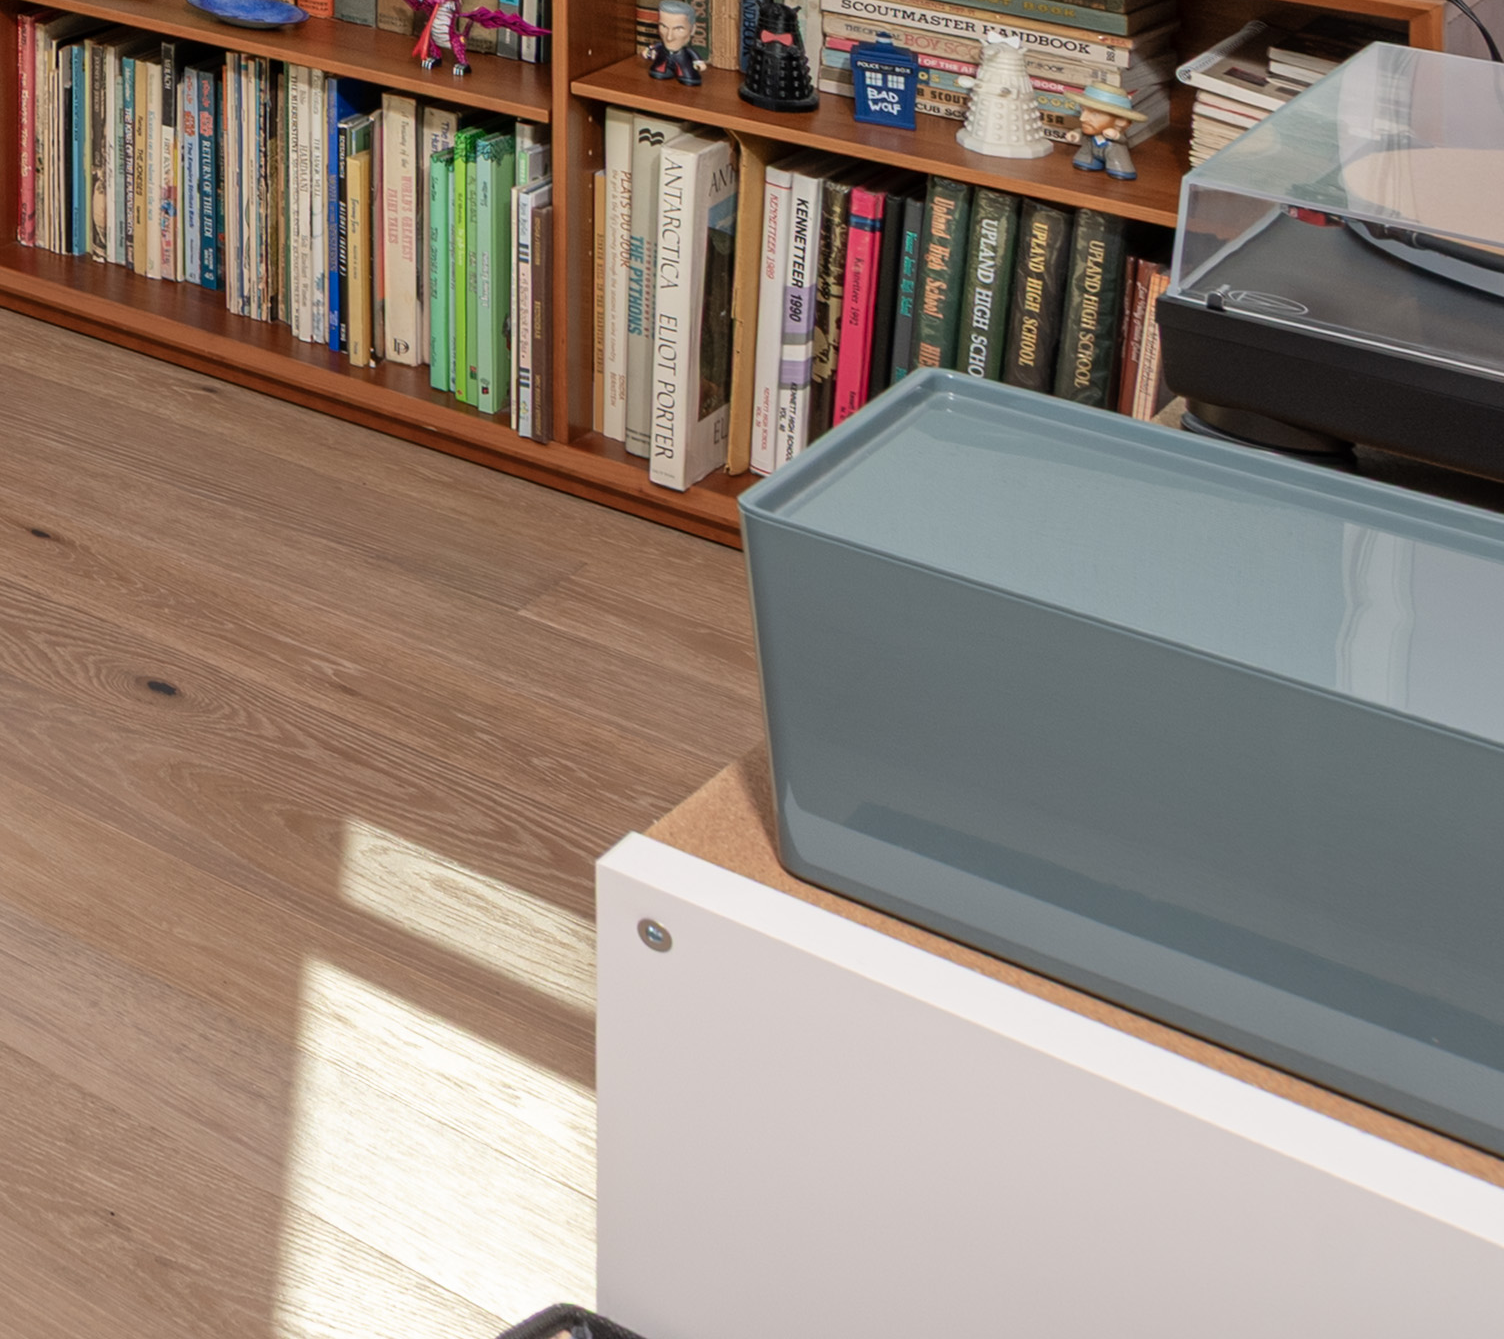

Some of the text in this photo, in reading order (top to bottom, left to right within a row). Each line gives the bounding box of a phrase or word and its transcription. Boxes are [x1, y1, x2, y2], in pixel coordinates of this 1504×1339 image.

[903, 34, 940, 56] BOY
[982, 23, 1092, 56] HANDBOOK
[1022, 0, 1078, 19] BOOK
[857, 60, 880, 72] POLICE
[867, 87, 899, 105] BAD
[868, 99, 903, 117] WOLF
[922, 56, 960, 74] OF THE
[186, 157, 196, 229] Empire Strikes Back
[202, 139, 214, 239] RETURN OF THE JEDI
[386, 188, 399, 245] FAIRY TALES
[400, 175, 414, 263] WORLD'S GREATEST
[619, 170, 632, 268] PLATS DU JOUR
[766, 193, 779, 280] KENNETTEER 1989
[788, 197, 809, 323] KENNETTEER 1990
[923, 196, 955, 319] Upland High School
[972, 218, 1000, 328] UPLAND HIGH
[628, 235, 644, 336] THE PYTHONS
[653, 156, 684, 459] ANTARCTICA ELIOT PORTER
[1017, 222, 1049, 366] UPLAND HIGH SCHOOL
[1073, 239, 1105, 388] UPLAND HIGH SCHOOL
